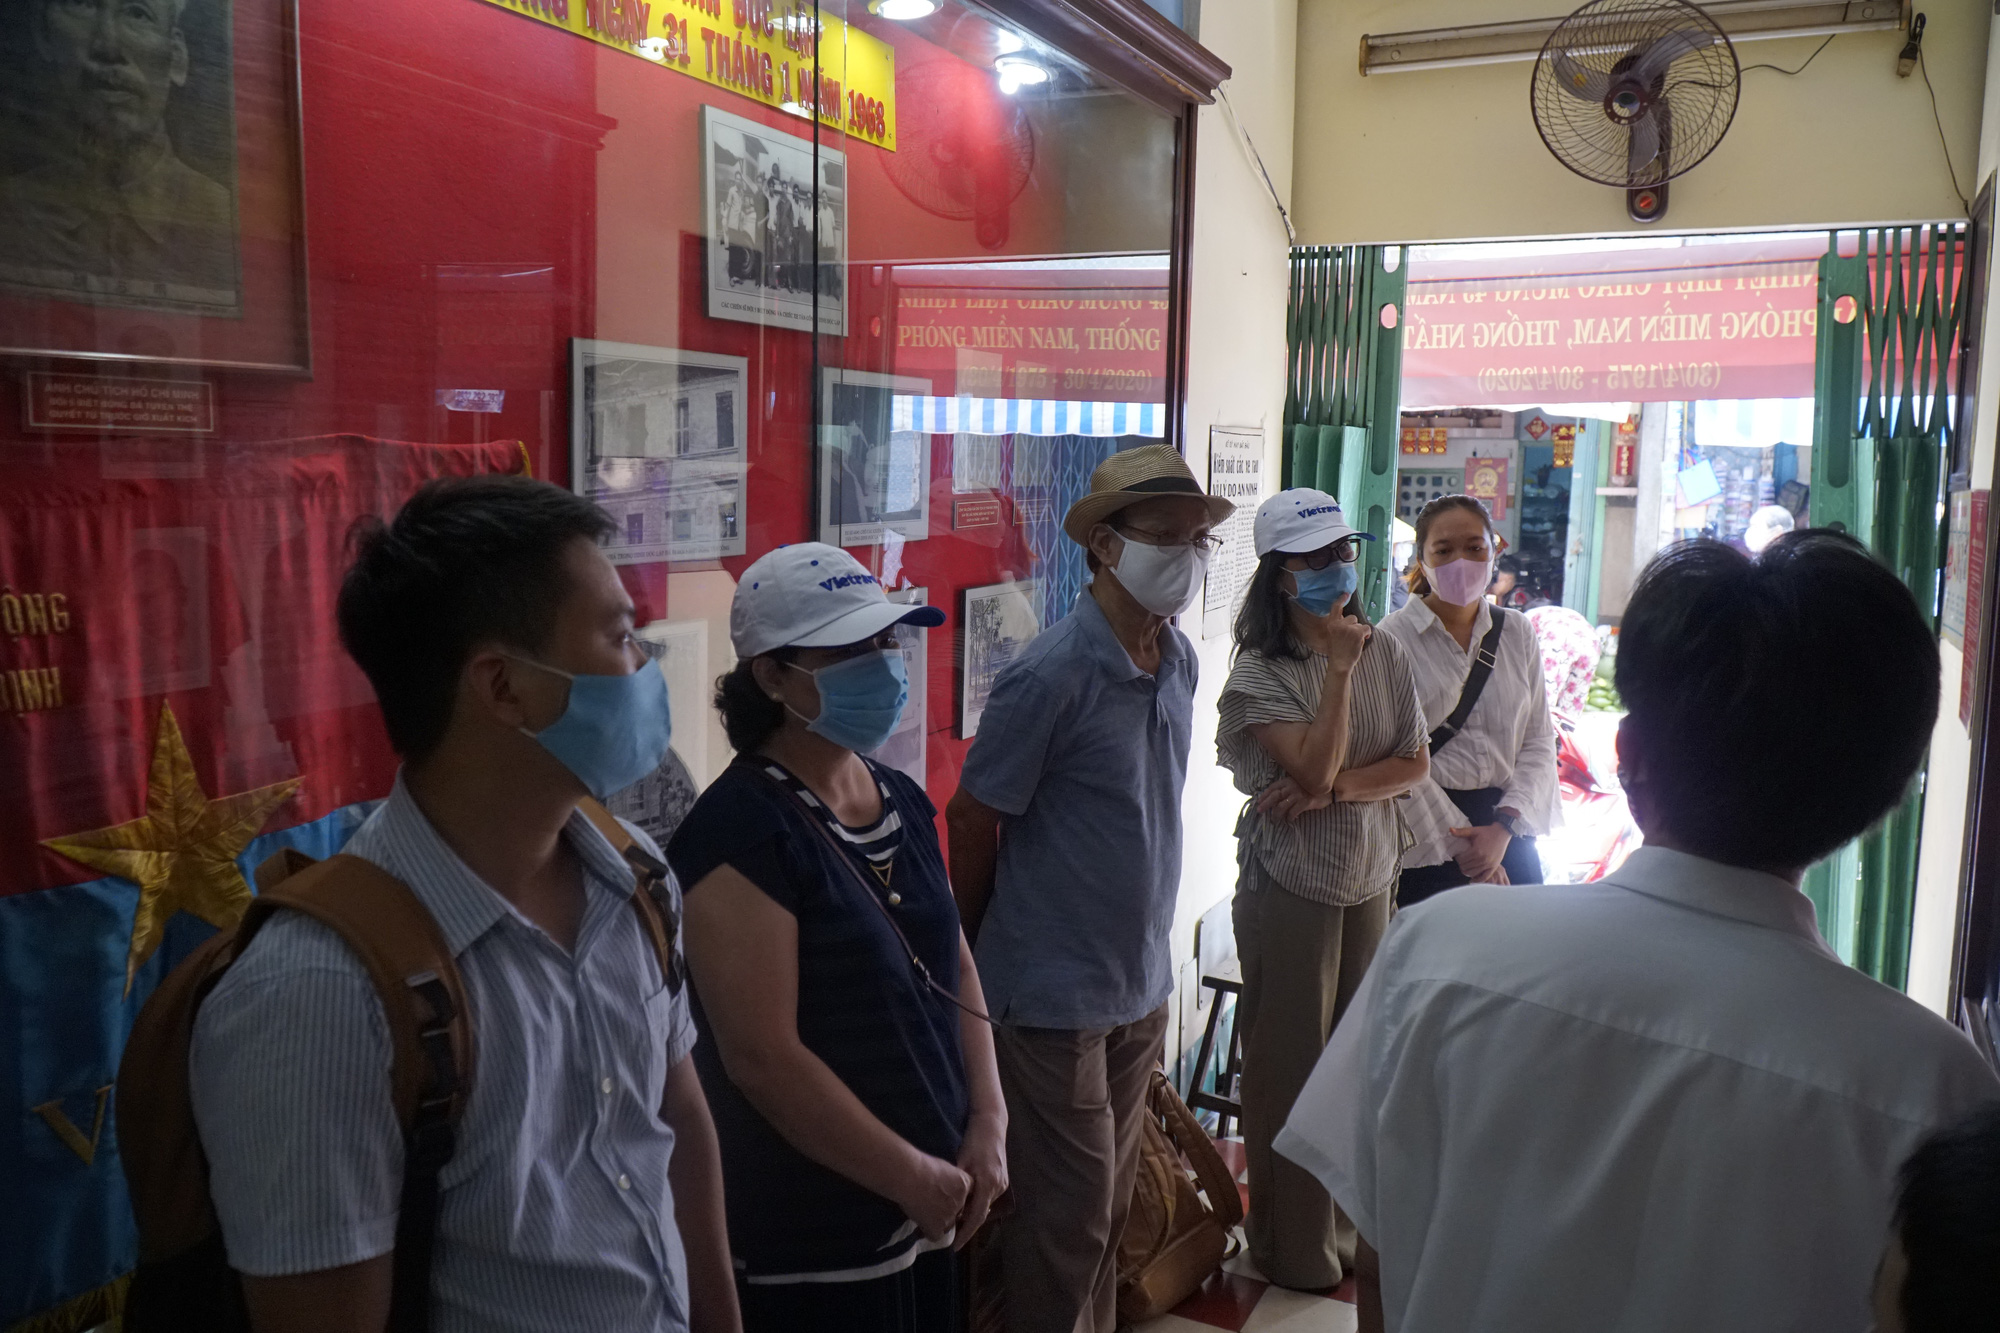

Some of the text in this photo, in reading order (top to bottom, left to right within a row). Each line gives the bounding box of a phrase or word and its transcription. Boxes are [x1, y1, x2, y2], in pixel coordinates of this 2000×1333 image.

[663, 13, 691, 64] 31
[701, 27, 774, 97] THÁNG
[780, 61, 793, 102] 1
[799, 66, 841, 121] NĂM
[848, 89, 886, 138] 1968
[898, 314, 1161, 353] PHÓNG MIỀN NAM, THỐNG
